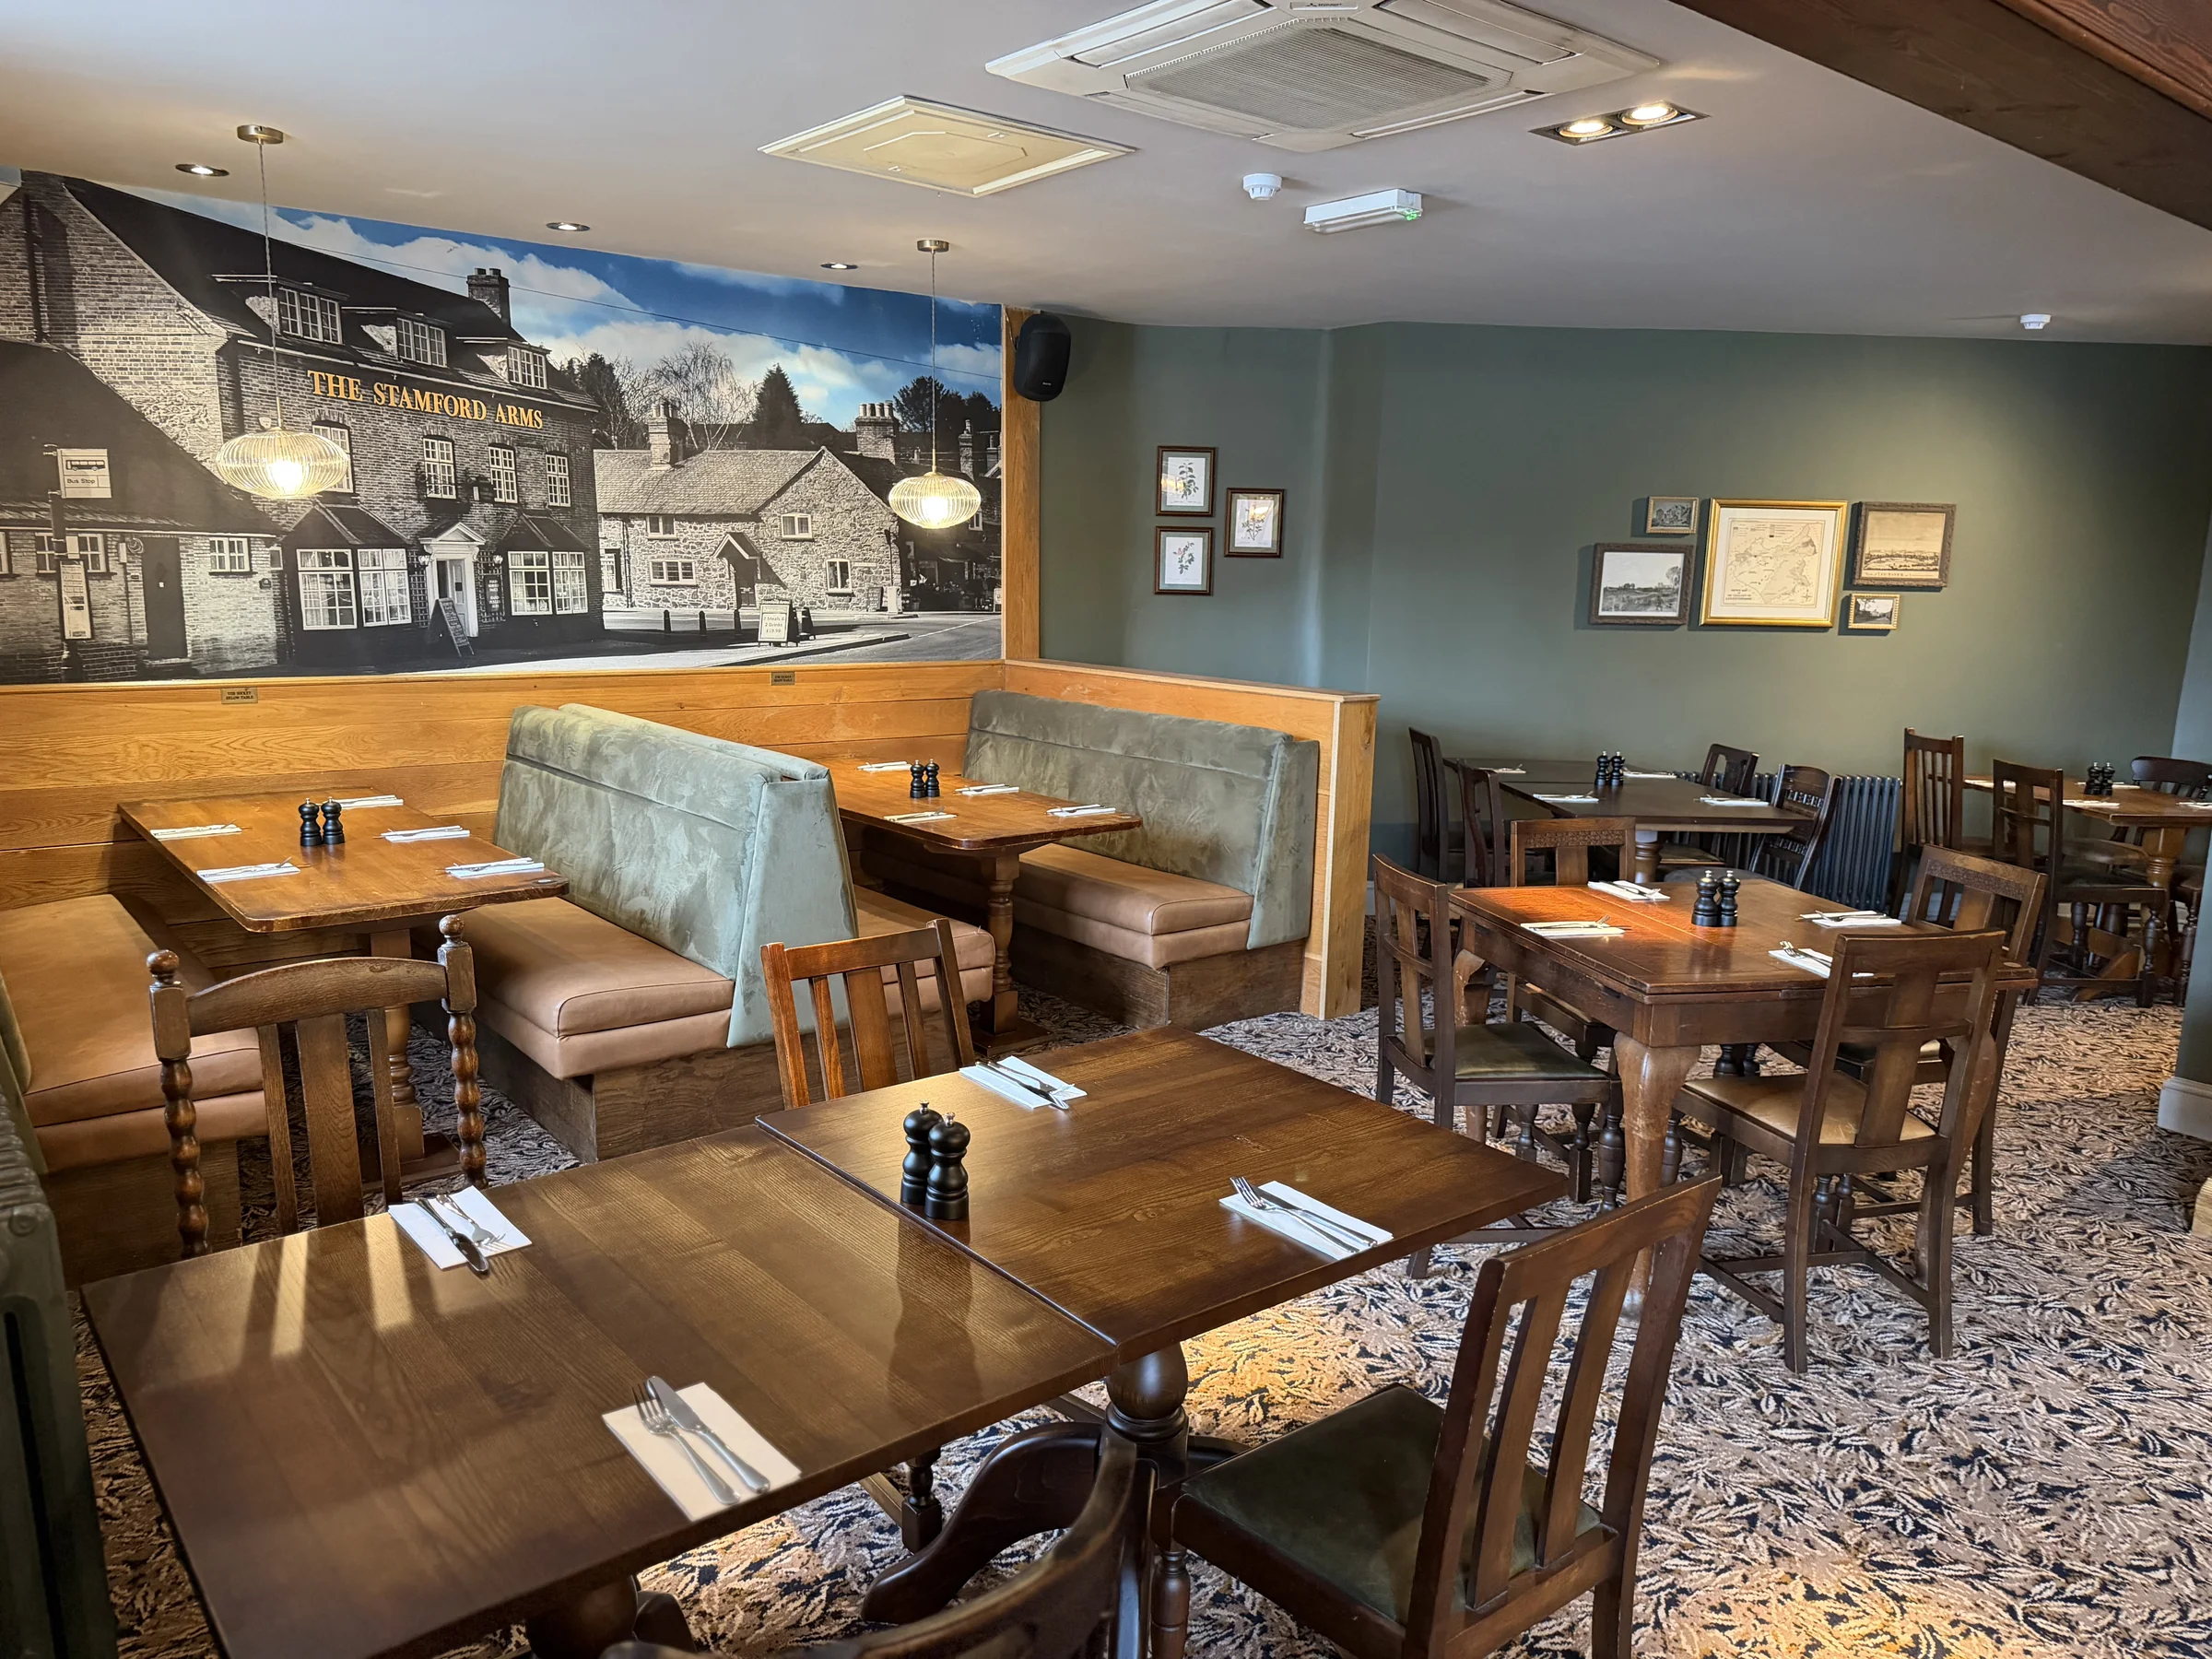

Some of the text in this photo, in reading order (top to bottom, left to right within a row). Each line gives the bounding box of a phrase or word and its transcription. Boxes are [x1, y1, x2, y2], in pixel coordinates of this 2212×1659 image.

[307, 370, 543, 429] THE STAMFORD ARMS
